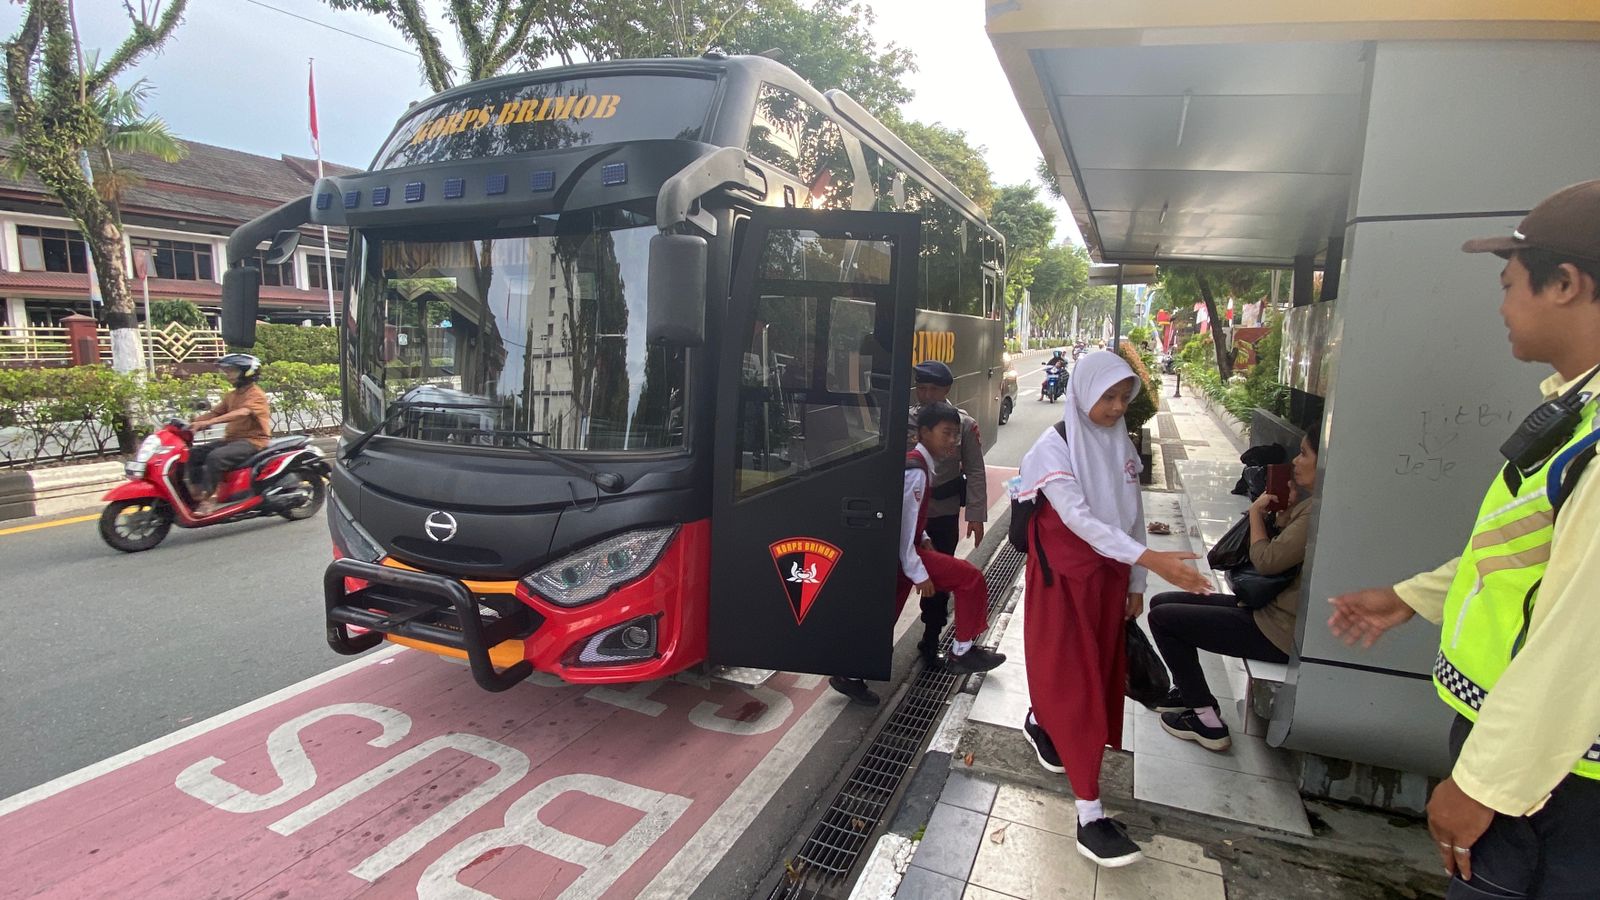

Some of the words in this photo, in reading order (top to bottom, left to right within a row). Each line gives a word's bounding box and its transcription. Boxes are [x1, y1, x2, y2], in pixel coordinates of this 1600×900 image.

[410, 105, 494, 145] KORPS
[495, 94, 621, 126] BRIMOB
[775, 541, 803, 556] KORPS
[804, 541, 836, 559] BRIMOB
[174, 701, 695, 900] BUS
